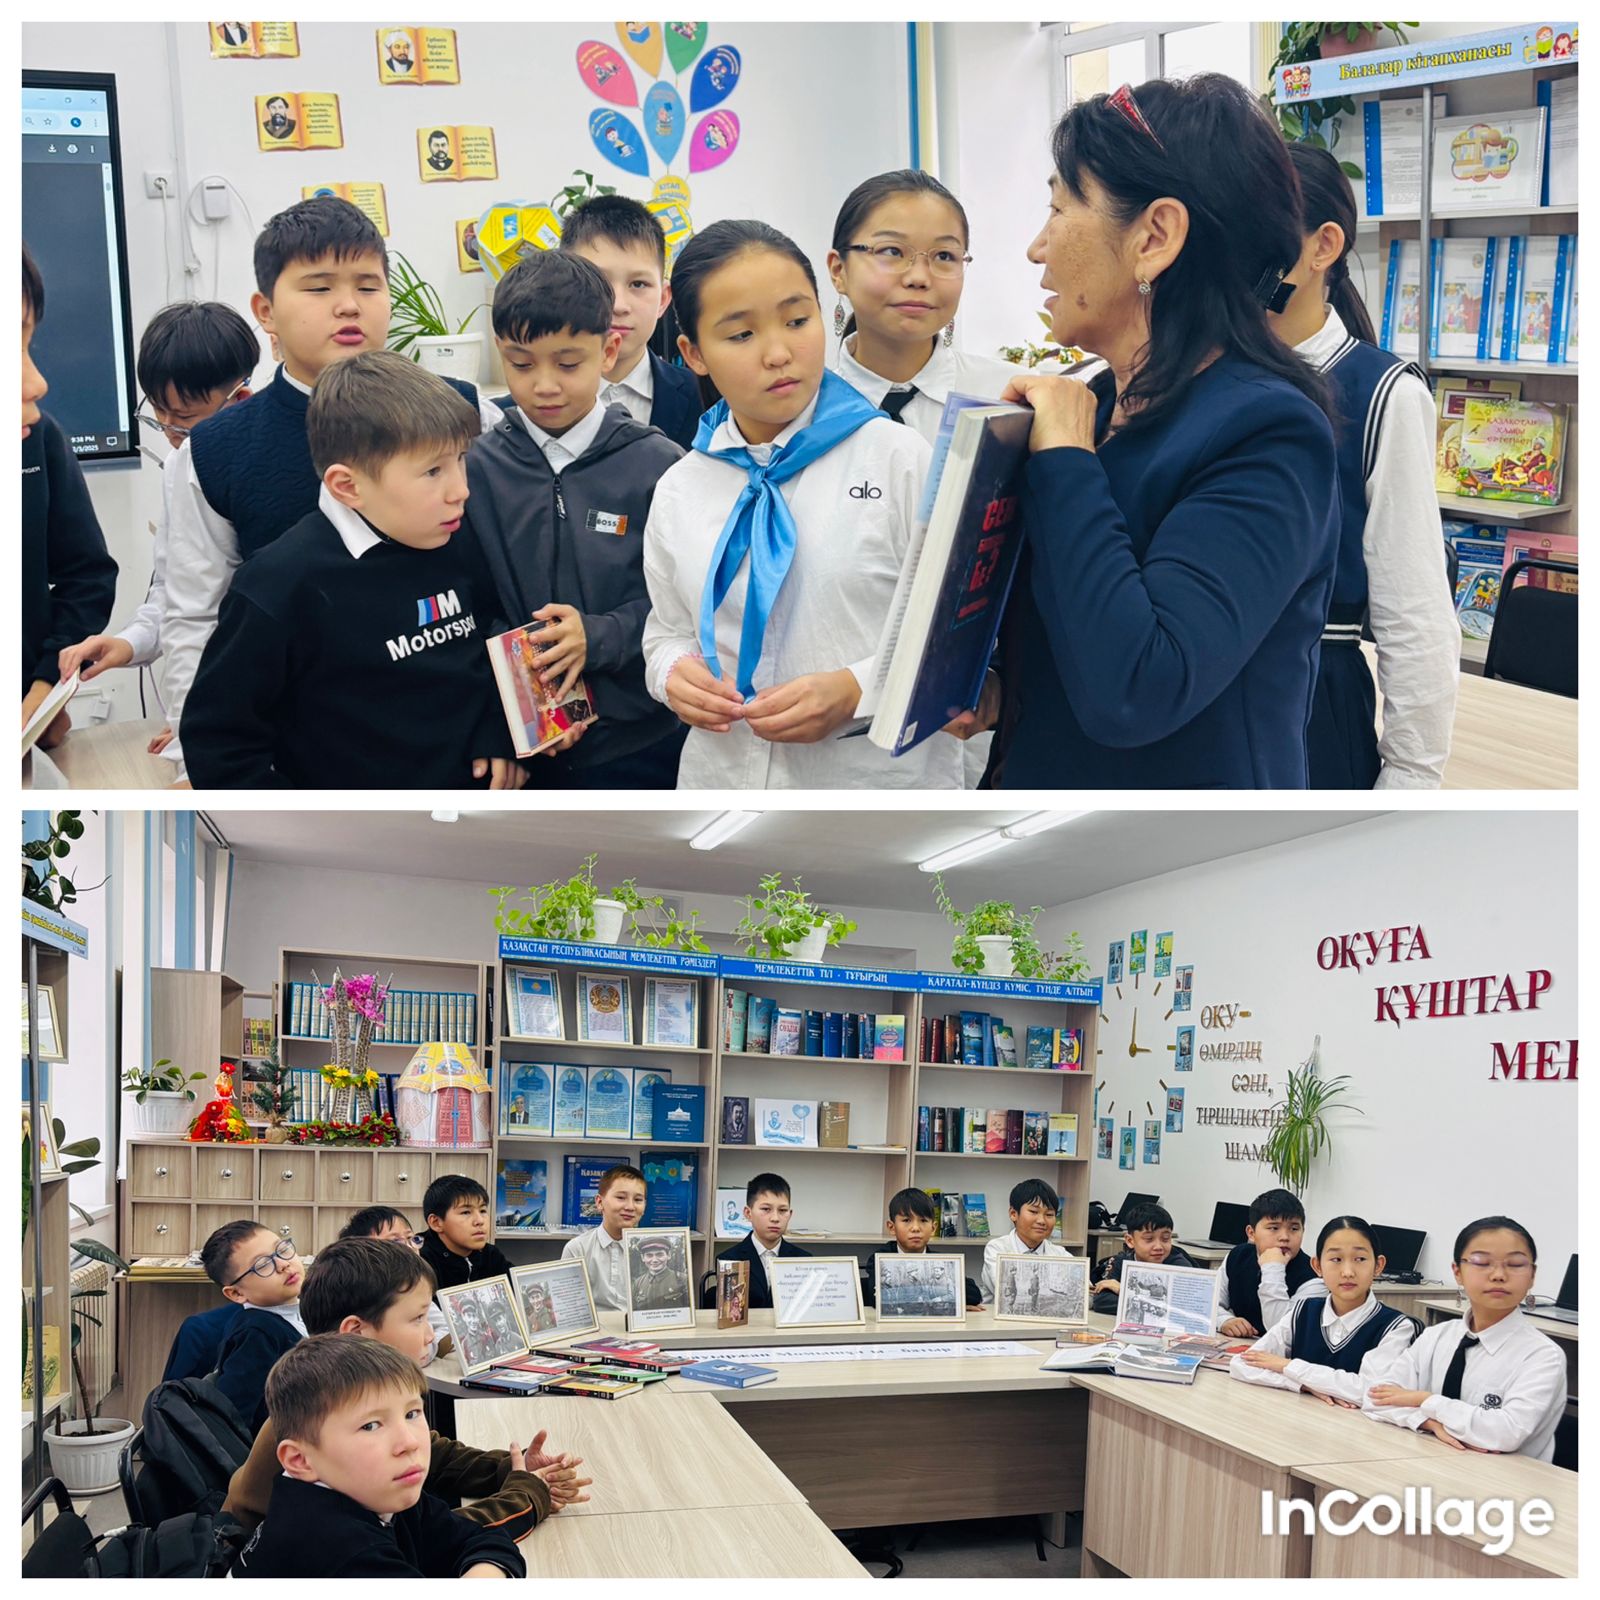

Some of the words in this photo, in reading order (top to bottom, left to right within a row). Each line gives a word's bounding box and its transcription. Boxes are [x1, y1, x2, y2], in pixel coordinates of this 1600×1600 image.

[1338, 61, 1404, 80] Балалар
[1406, 41, 1512, 72] кітапханасы
[849, 480, 882, 499] alo
[436, 589, 462, 619] M
[502, 940, 548, 954] ҚАЗАҚСТАН
[551, 945, 628, 961] РЕСПУБЛИКАСЫНЫҢ
[630, 954, 677, 966] МЕМЛЕКЕТТІК
[680, 957, 718, 969] РӘМІЗДЕРІ
[1317, 924, 1432, 974] ОҚУҒА
[754, 963, 815, 978] МЕМЛЕКЕТТІК
[820, 969, 833, 979] ТІЛ
[1036, 985, 1062, 995] ТҮНДЕ
[1064, 987, 1093, 996] АЛТЫН
[1374, 969, 1553, 1029] ҚҰШТАР
[1200, 1041, 1262, 1062] ӨМІРДІҢ
